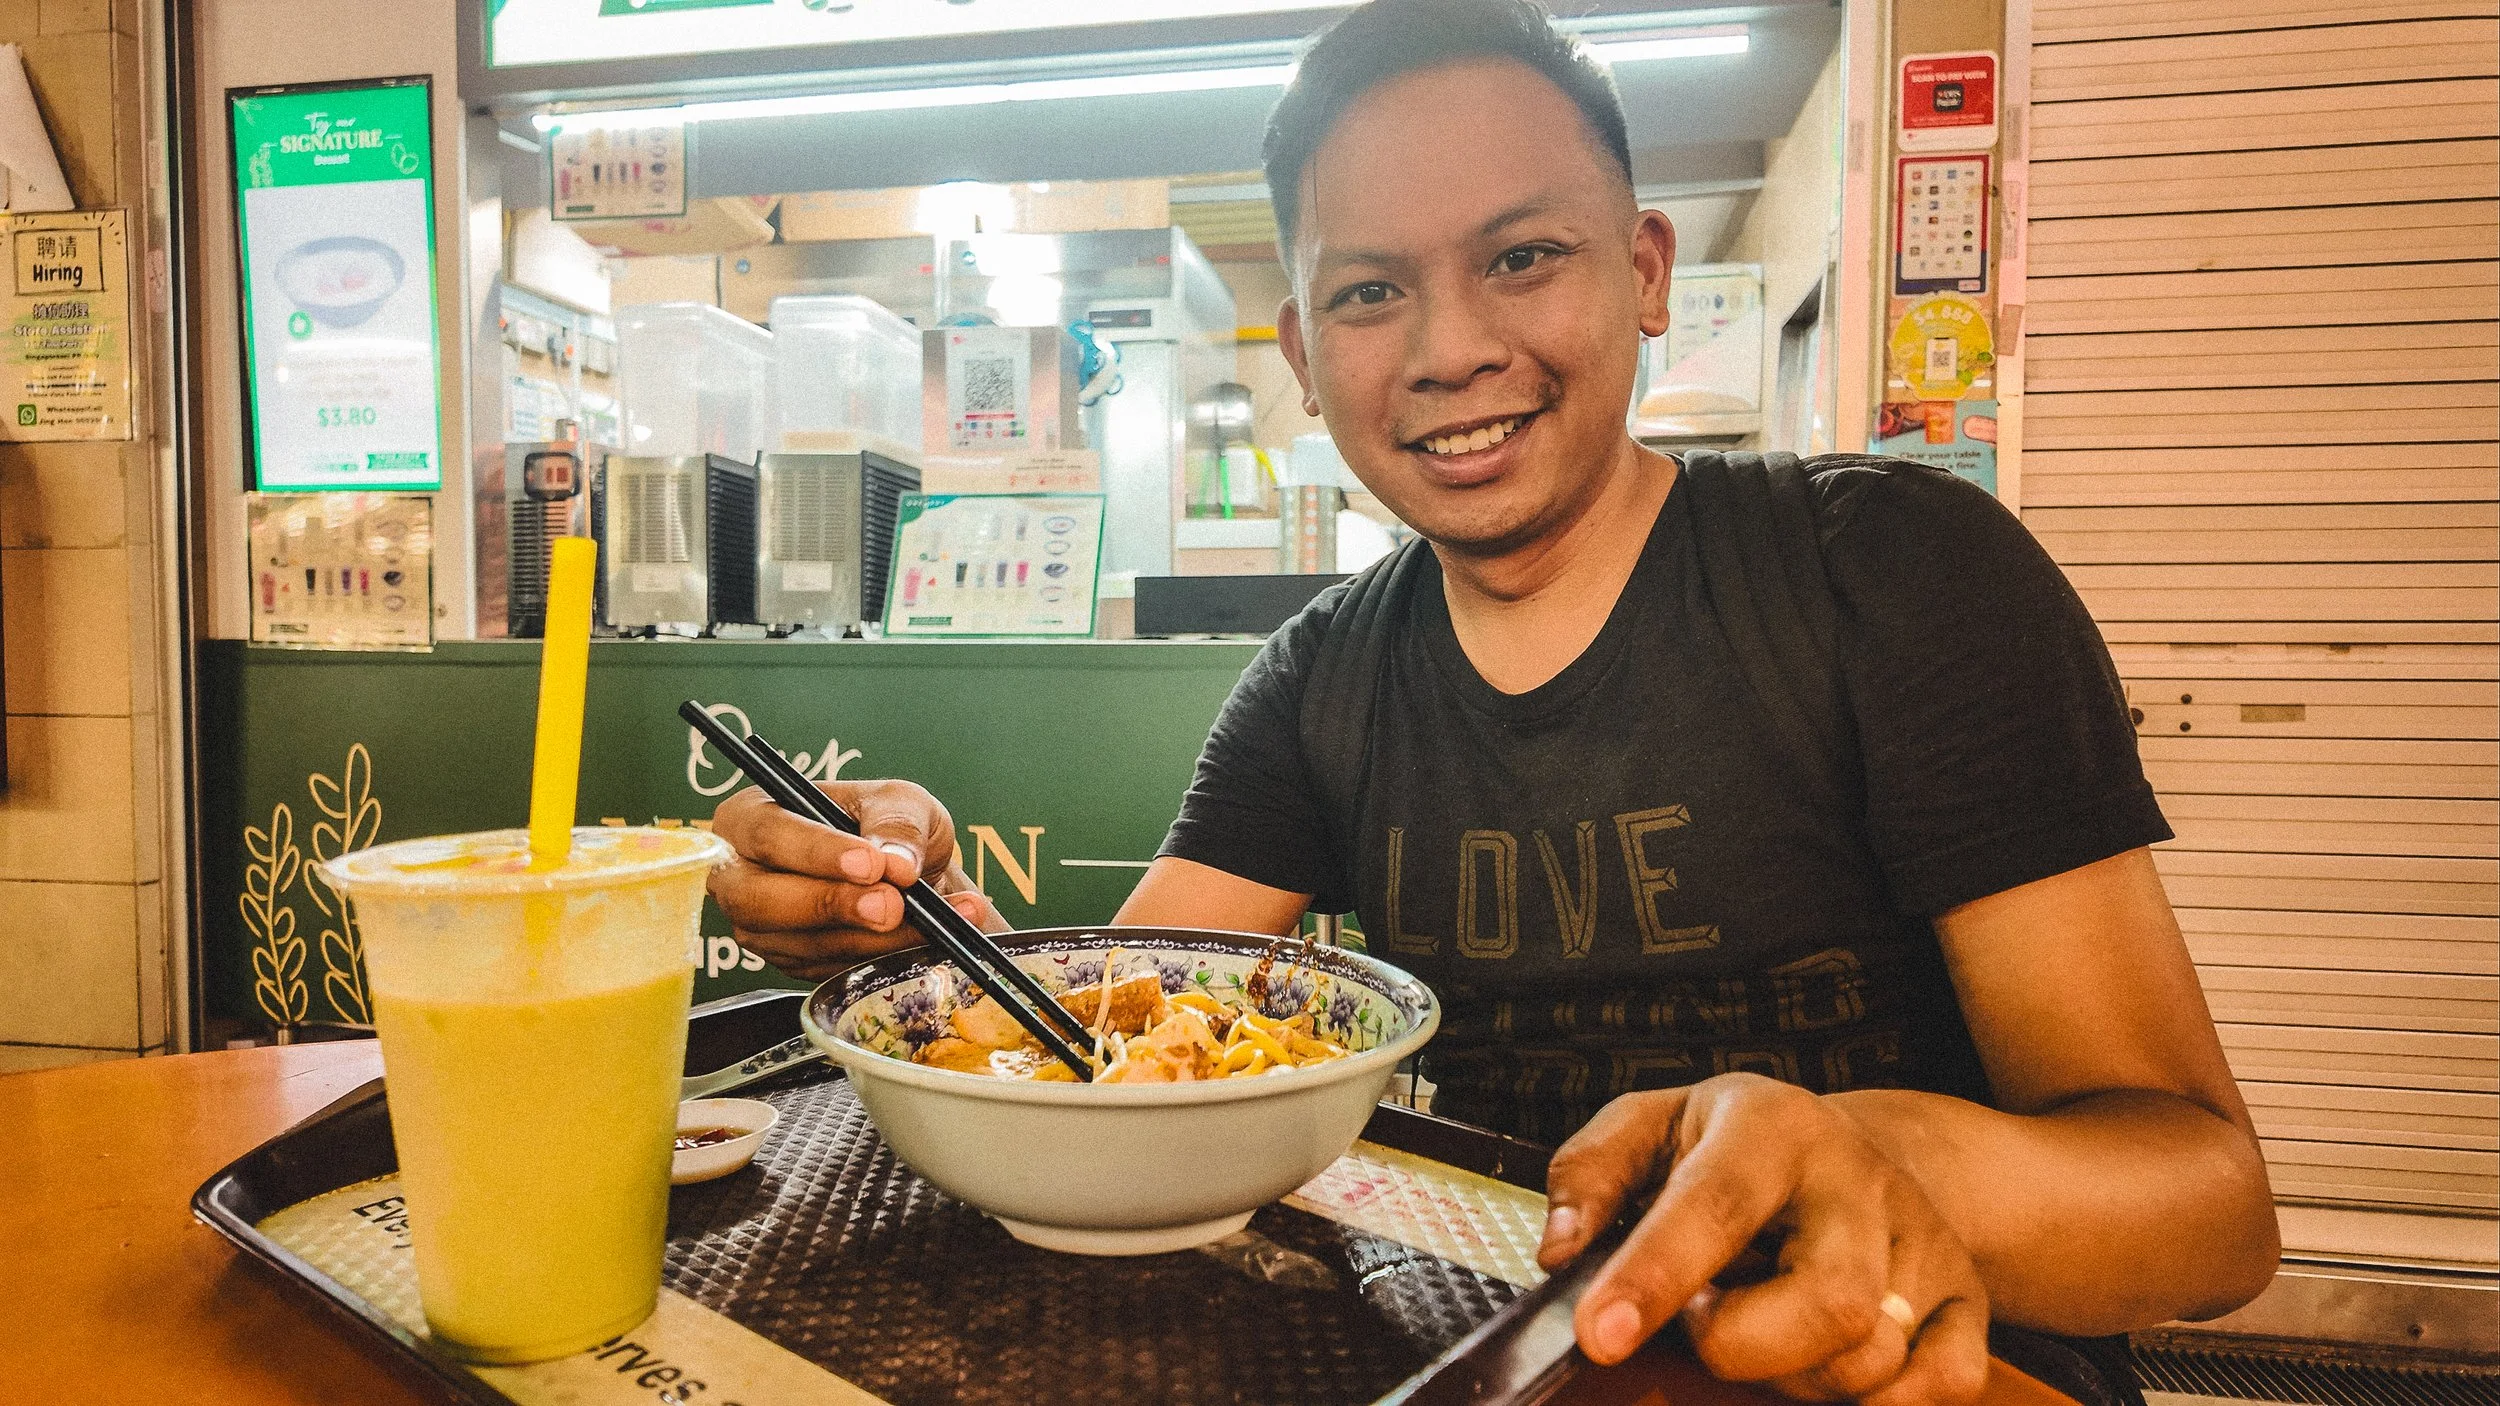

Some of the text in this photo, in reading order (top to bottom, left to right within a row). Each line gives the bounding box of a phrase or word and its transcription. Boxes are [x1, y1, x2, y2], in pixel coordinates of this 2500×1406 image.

[280, 128, 384, 154] SIGNATURE
[37, 235, 77, 259] 聘请
[33, 263, 83, 288] Hiring
[316, 405, 378, 428] $3.80
[688, 703, 863, 797] Oer
[1386, 803, 1721, 960] LOVE
